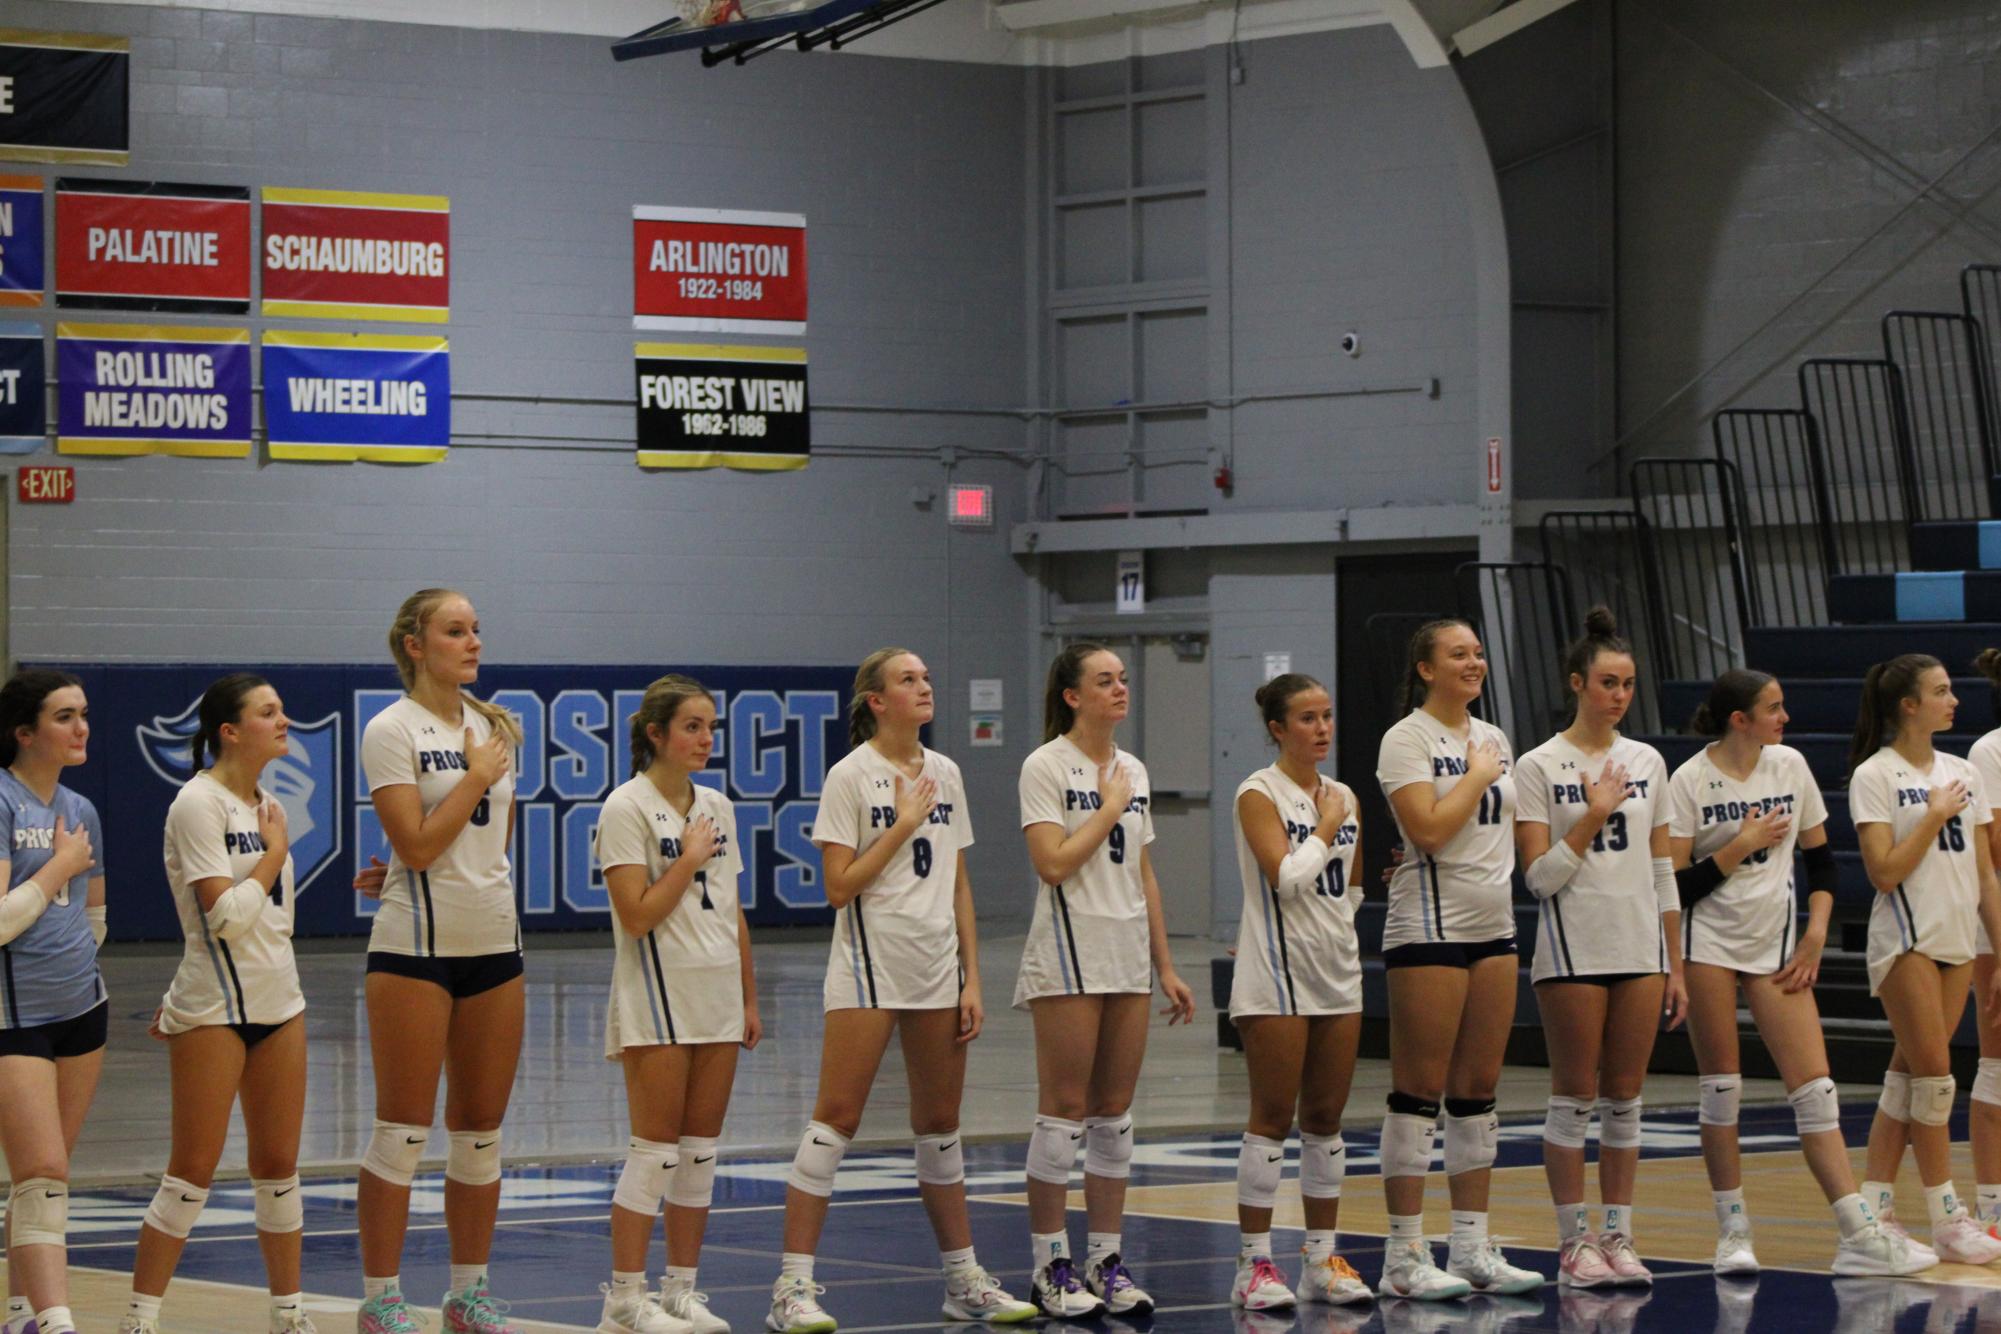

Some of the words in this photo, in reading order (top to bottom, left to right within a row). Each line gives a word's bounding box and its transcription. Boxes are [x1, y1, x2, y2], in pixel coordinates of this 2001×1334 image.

[88, 227, 219, 266] PALATINE
[266, 234, 444, 277] SCHAUMBURG
[650, 239, 789, 277] ARLINGTON
[678, 278, 763, 301] 1922-1984
[96, 351, 214, 389] ROLLING
[84, 391, 228, 430] MEADOWS
[288, 377, 427, 416] WHEELING
[640, 375, 735, 411] FOREST
[740, 378, 804, 413] VIEW
[682, 413, 767, 437] 1962-1986
[30, 469, 67, 498] EXIT
[1122, 572, 1139, 601] 17
[1479, 785, 1502, 825] 11
[1109, 822, 1125, 864] 9
[1593, 811, 1628, 853] 13
[1938, 815, 1965, 853] 16
[912, 837, 932, 878] 8
[1315, 857, 1345, 897] 10
